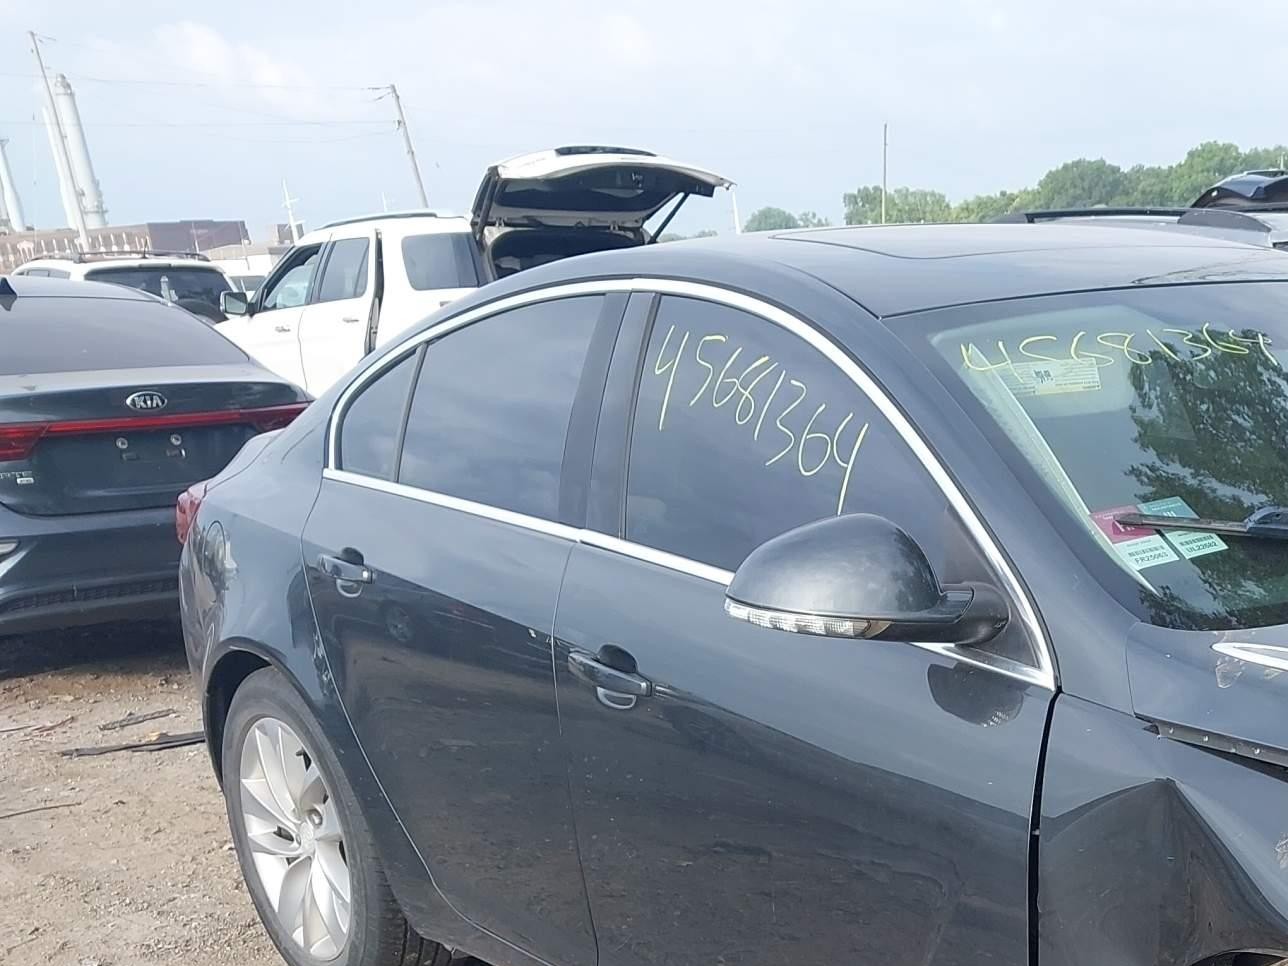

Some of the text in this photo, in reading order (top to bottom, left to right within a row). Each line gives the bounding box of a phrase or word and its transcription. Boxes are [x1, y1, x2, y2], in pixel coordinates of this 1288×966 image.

[960, 322, 1278, 383] 45681364
[134, 396, 162, 409] KIA
[655, 324, 869, 516] 45681364
